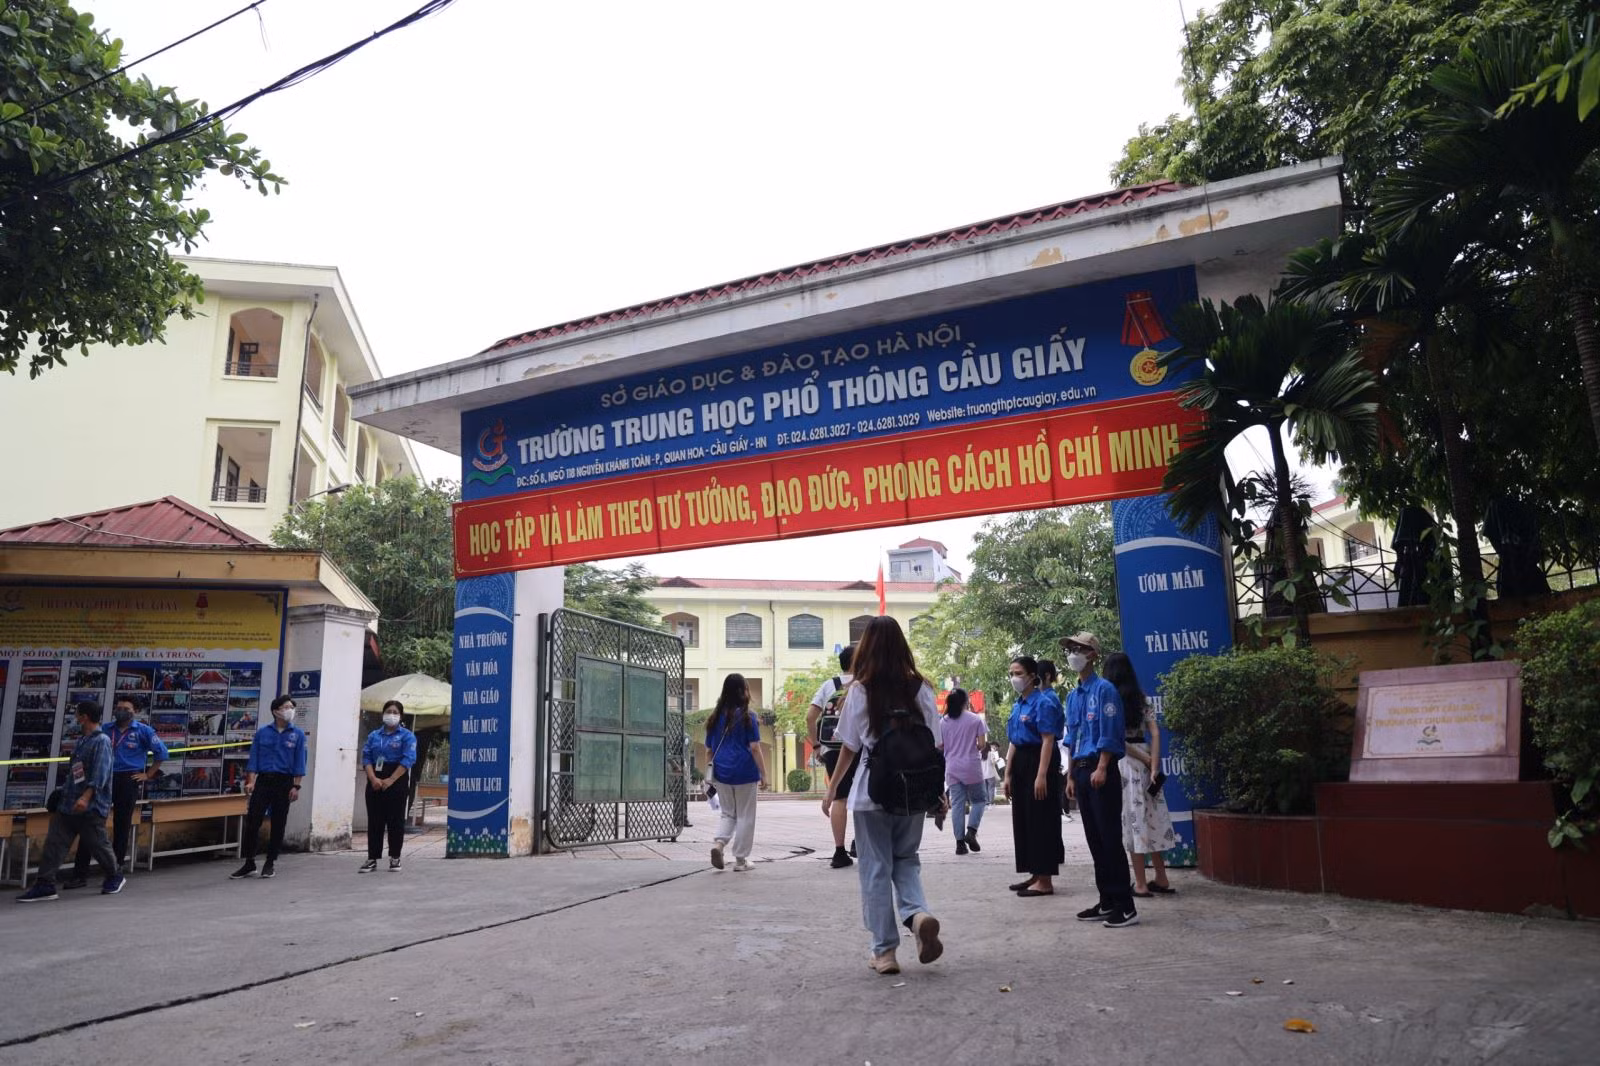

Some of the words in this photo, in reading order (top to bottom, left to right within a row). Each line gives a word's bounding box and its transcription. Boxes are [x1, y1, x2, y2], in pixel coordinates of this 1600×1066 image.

[601, 383, 626, 408] SỞ
[633, 377, 686, 401] GIÁO
[692, 369, 735, 391] DỤC
[741, 365, 756, 381] &
[762, 352, 814, 377] ĐÀO
[821, 343, 869, 366] TẠO
[877, 331, 910, 356] HÀ
[916, 323, 961, 348] NỘI
[517, 423, 605, 465] TRƯỜNG
[611, 406, 694, 448] TRUNG
[701, 396, 755, 435] HỌC
[763, 369, 820, 422] PHỔ
[828, 365, 929, 410] THÔNG
[938, 342, 1002, 392] CẦU
[1011, 326, 1086, 380] GIẤY
[576, 459, 604, 477] NGUYỄN
[605, 458, 629, 473] KHÁNH
[663, 449, 687, 464] QUAN
[687, 446, 705, 460] HOA
[710, 438, 728, 456] CẦU
[729, 434, 749, 453] GIẤY
[755, 436, 768, 449] HN
[791, 423, 851, 443] 024.6281.3027
[857, 412, 920, 433] 024.6281.3029
[926, 406, 966, 423] Website:
[469, 522, 501, 562] HỌC
[504, 511, 536, 557] TẬP
[539, 505, 563, 547] VÀ
[566, 501, 604, 543] LÀM
[607, 498, 654, 537] THEO
[656, 490, 682, 530] TƯ
[685, 476, 758, 526] TƯỞNG,
[761, 477, 804, 525] ĐẠO
[808, 465, 859, 512] ĐỨC,
[863, 457, 942, 505] PHONG
[947, 444, 1012, 494] CÁCH
[1017, 428, 1052, 486] HỒ
[1058, 425, 1102, 480] CHÍ
[1108, 424, 1180, 473] MINH
[1138, 572, 1169, 593] ƯƠM
[1171, 564, 1205, 590] MẦM
[459, 631, 475, 649] NHÀ
[476, 629, 508, 648] TRƯỜNG
[1145, 630, 1169, 653] TÀI
[1171, 628, 1209, 651] NĂNG
[466, 660, 481, 677] VĂN
[482, 658, 499, 676] HÓA
[299, 673, 310, 690] 8
[463, 687, 479, 705] NHÀ
[480, 686, 500, 704] GIÁO
[462, 714, 480, 734] MẪU
[481, 717, 499, 736] MỰC
[461, 748, 477, 765] HỌC
[478, 747, 498, 762] SINH
[455, 776, 482, 792] THANH
[483, 776, 502, 795] LỊCH
